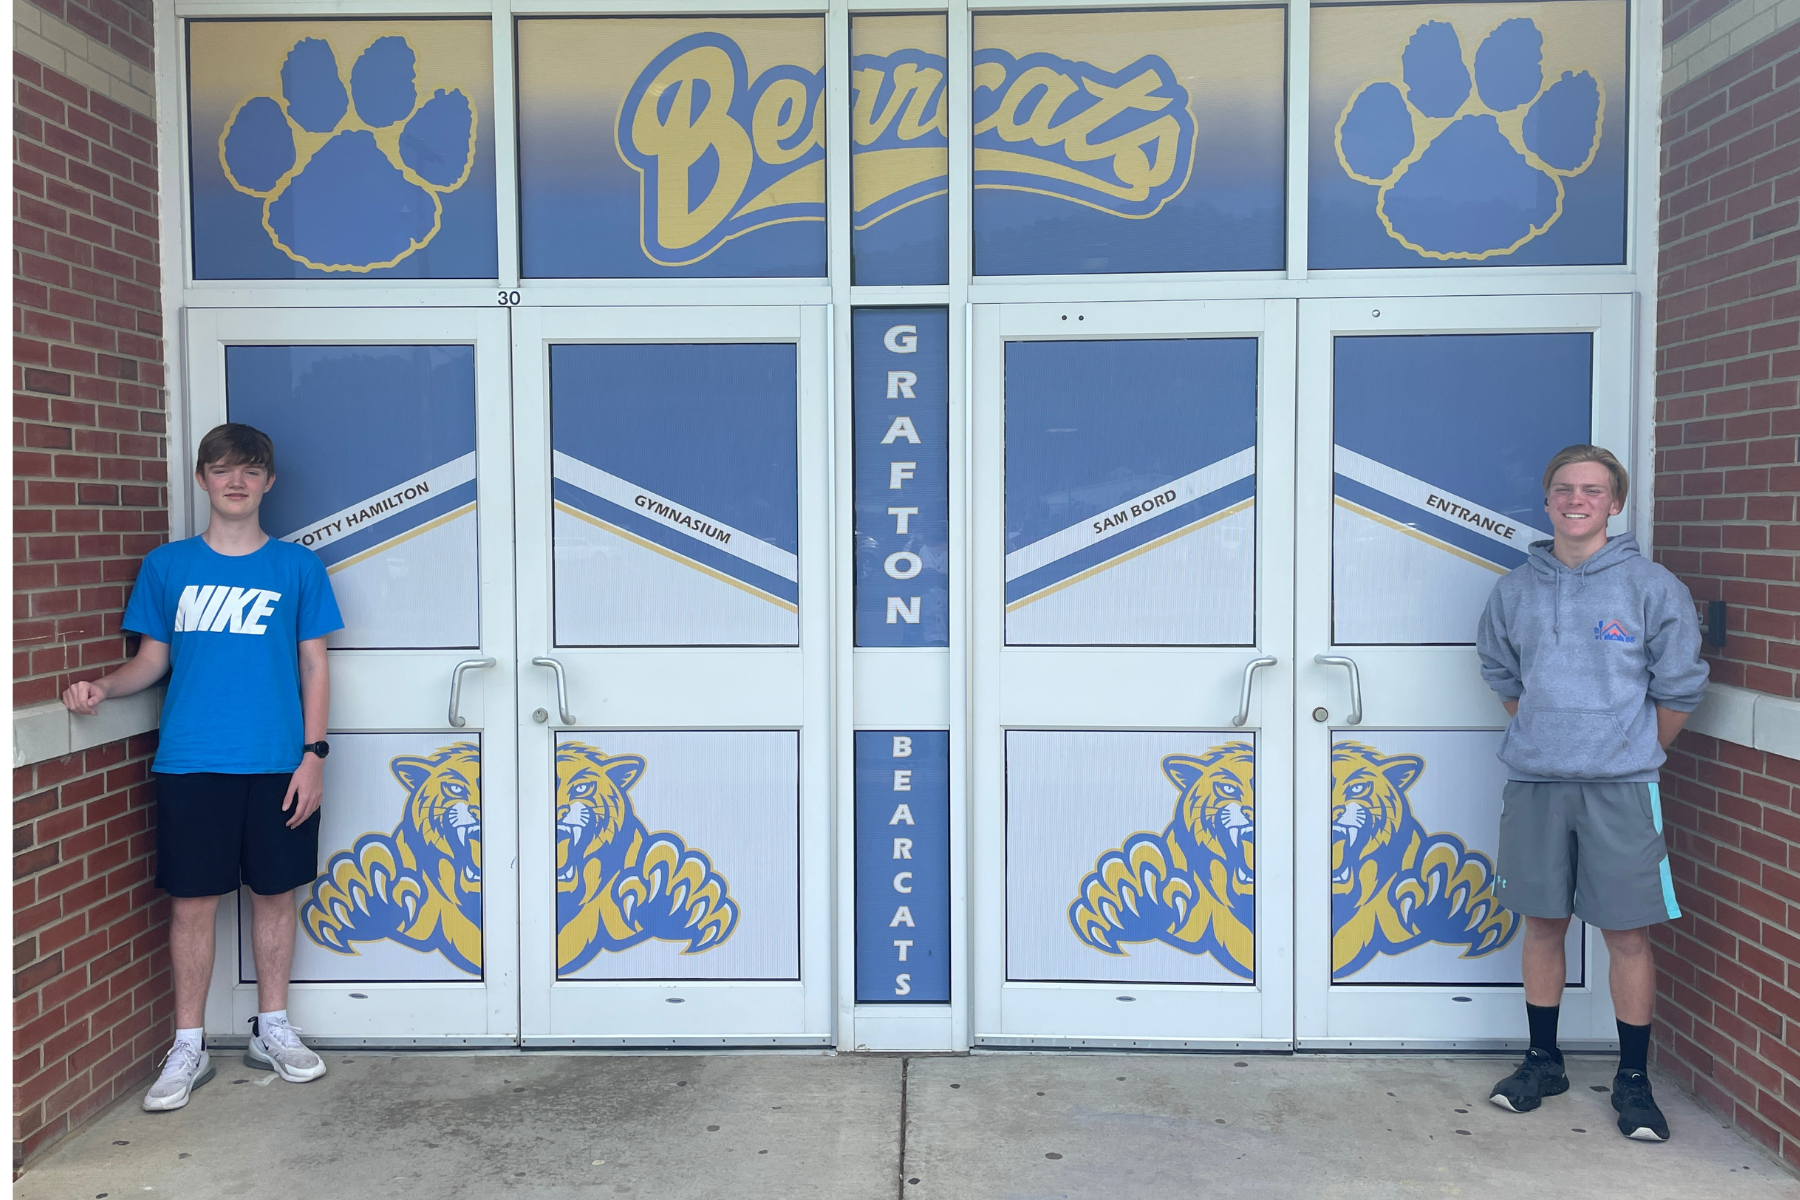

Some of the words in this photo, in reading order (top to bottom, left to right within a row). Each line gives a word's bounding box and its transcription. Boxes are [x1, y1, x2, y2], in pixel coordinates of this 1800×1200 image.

[632, 45, 1180, 250] Bearcats
[498, 291, 520, 305] 30
[880, 324, 923, 624] GRAFTON
[346, 481, 429, 527] HAMILTON
[634, 495, 731, 544] GYMNASIUM
[1093, 510, 1129, 534] SAM
[1130, 489, 1177, 518] BORD
[1426, 494, 1516, 539] ENTRANCE
[174, 584, 282, 635] NIKE
[889, 736, 915, 995] BEARCATS
